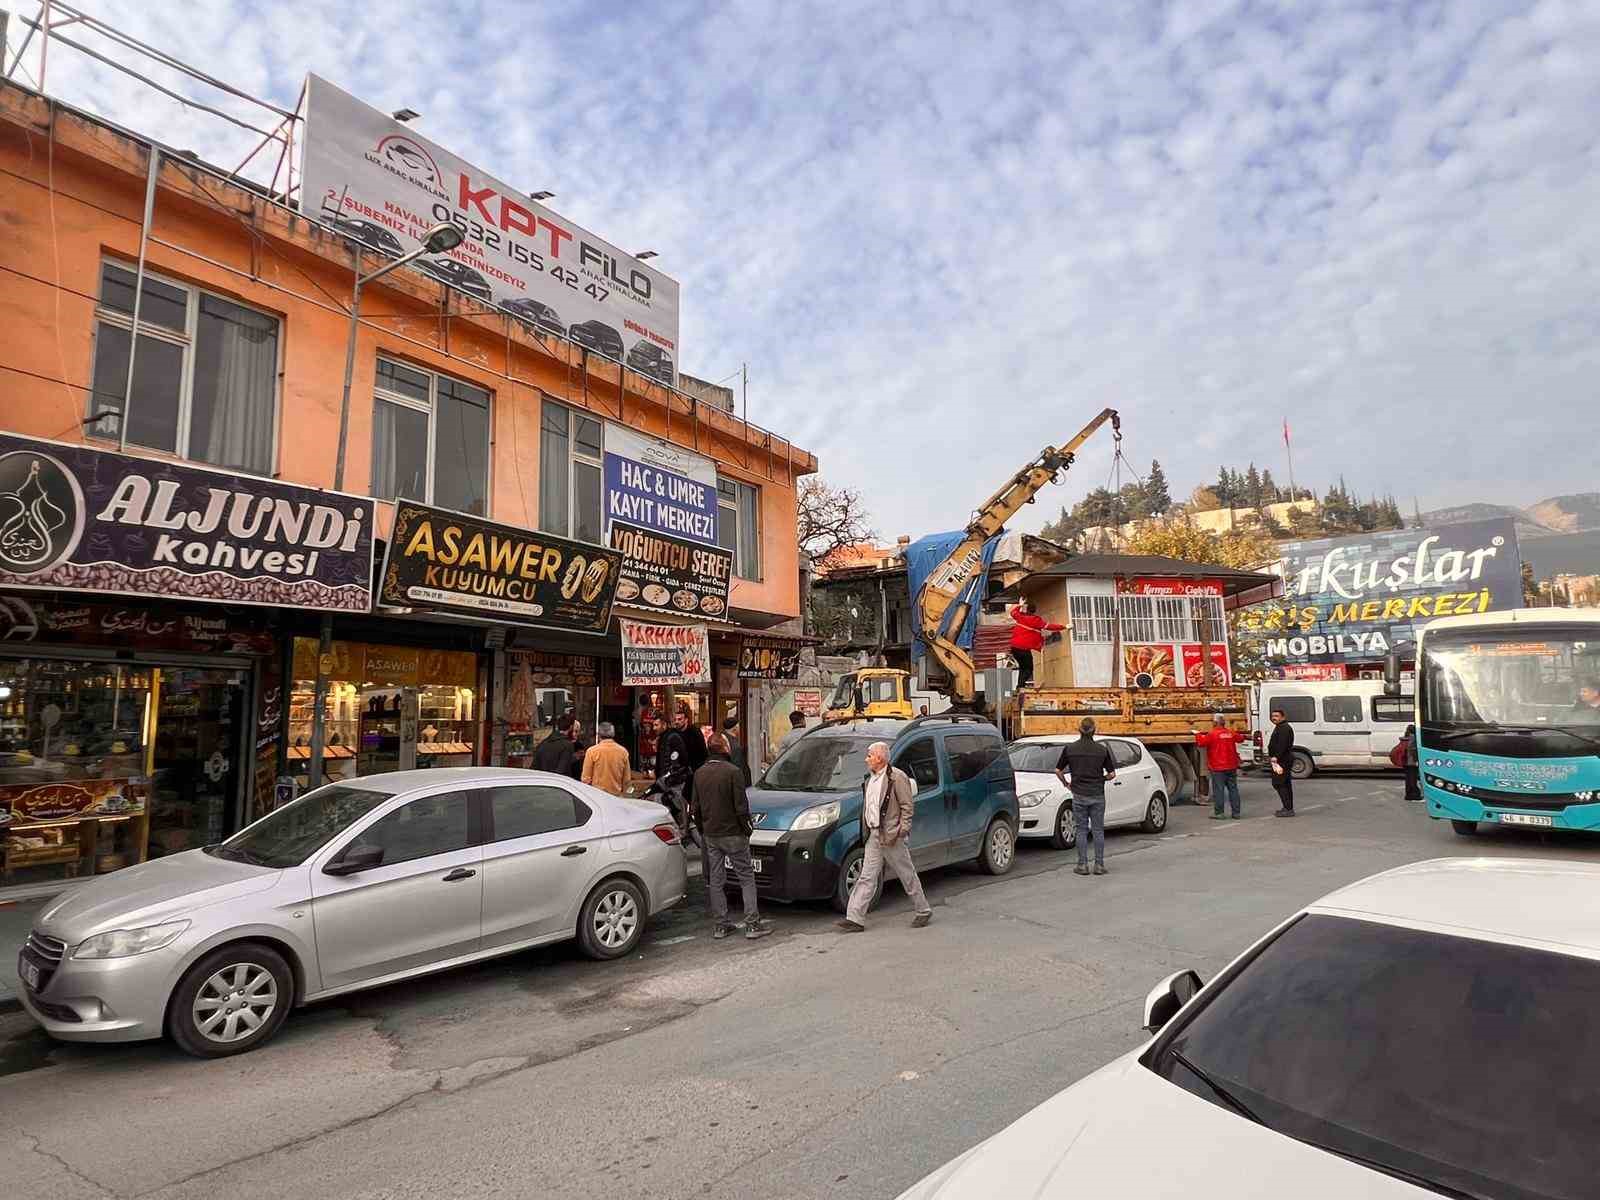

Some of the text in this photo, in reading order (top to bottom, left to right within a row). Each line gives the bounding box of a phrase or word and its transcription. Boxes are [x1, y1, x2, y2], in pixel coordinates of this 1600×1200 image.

[458, 172, 573, 259] KPT
[432, 203, 610, 302] 0532 155 42 47
[620, 461, 652, 494] HAC
[654, 472, 666, 497] &
[667, 476, 705, 509] UMRE
[609, 488, 715, 540] KAYIT MERKEZİ
[403, 520, 563, 585] ASAWER
[613, 528, 731, 579] YOĞURTÇU ŞEREF
[1327, 587, 1490, 624] MERKEZİ
[626, 661, 678, 675] KAMPANYA
